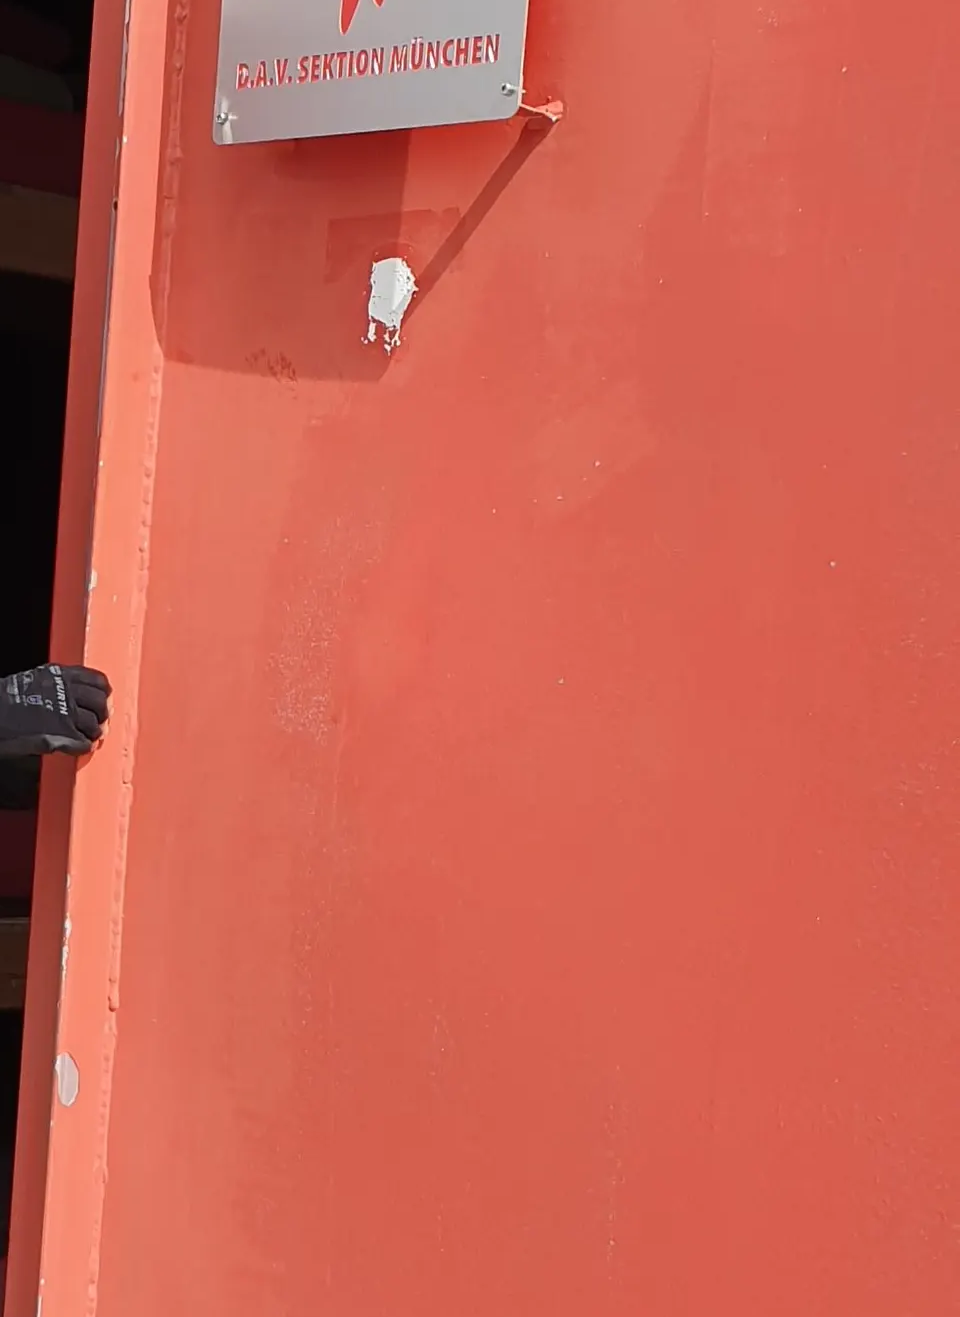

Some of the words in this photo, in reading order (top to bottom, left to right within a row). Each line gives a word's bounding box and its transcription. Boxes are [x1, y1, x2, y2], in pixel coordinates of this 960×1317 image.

[236, 58, 293, 91] D.A.V.
[295, 47, 385, 85] SEKTION
[388, 34, 501, 74] MÜNCHEN
